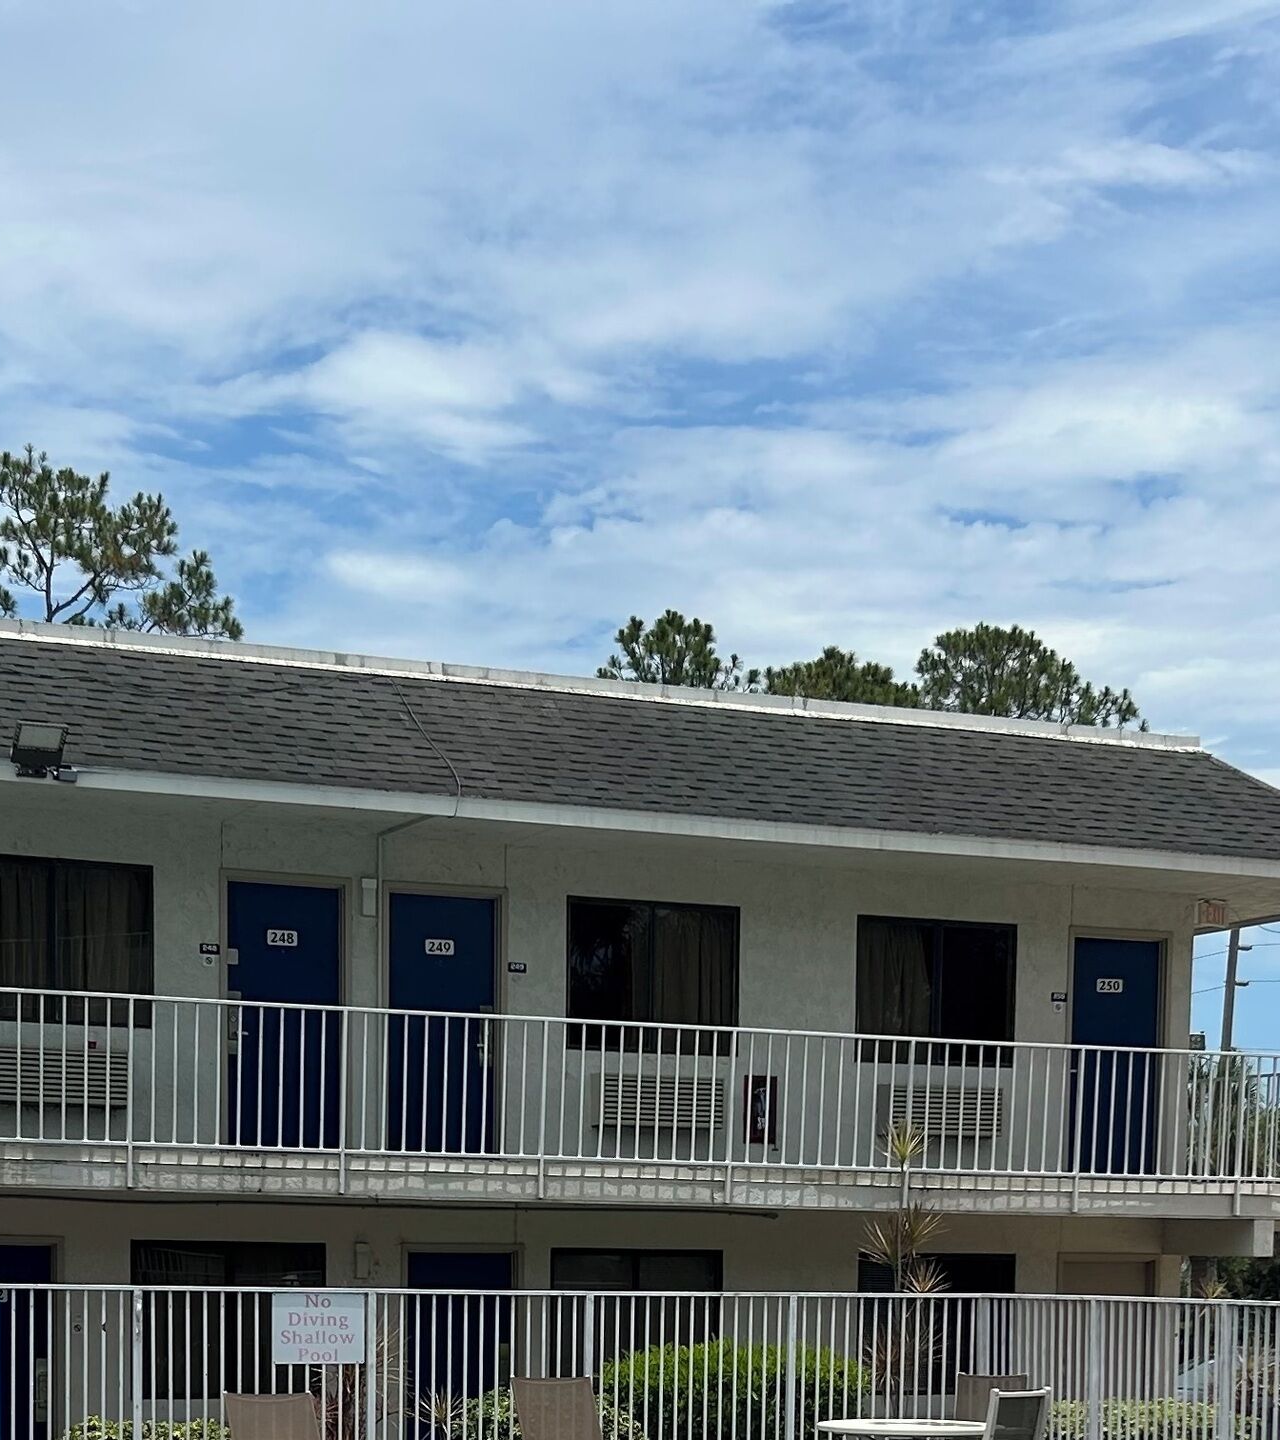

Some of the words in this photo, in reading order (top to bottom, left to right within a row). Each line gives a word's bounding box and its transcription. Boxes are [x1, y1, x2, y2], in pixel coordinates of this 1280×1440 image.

[270, 932, 295, 945] 248
[427, 941, 451, 953] 249
[1099, 980, 1120, 991] 250
[305, 1294, 332, 1309] No
[288, 1312, 349, 1330] Diving
[280, 1330, 355, 1345] Shallow
[298, 1348, 339, 1362] Pool
